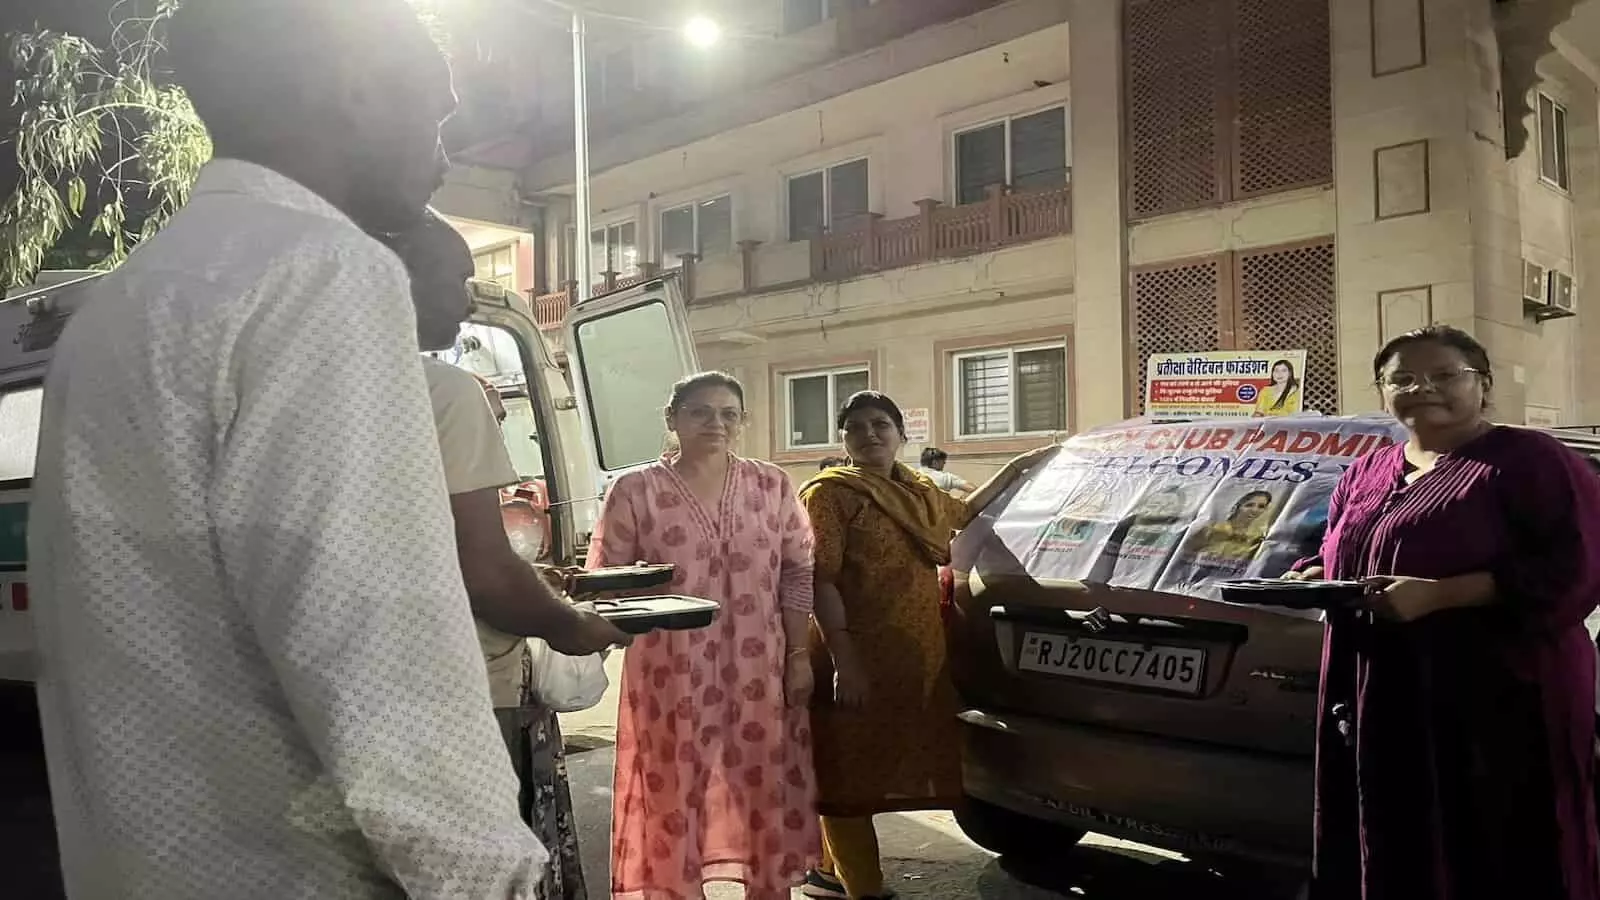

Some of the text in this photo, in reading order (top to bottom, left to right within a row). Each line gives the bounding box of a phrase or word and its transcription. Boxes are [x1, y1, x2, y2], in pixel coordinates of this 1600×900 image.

[1157, 358, 1185, 376] प्रतीक्षा
[1145, 427, 1232, 452] CLUB
[1096, 455, 1319, 483] ELCOMES
[1037, 640, 1195, 683] RJ20CC7405
